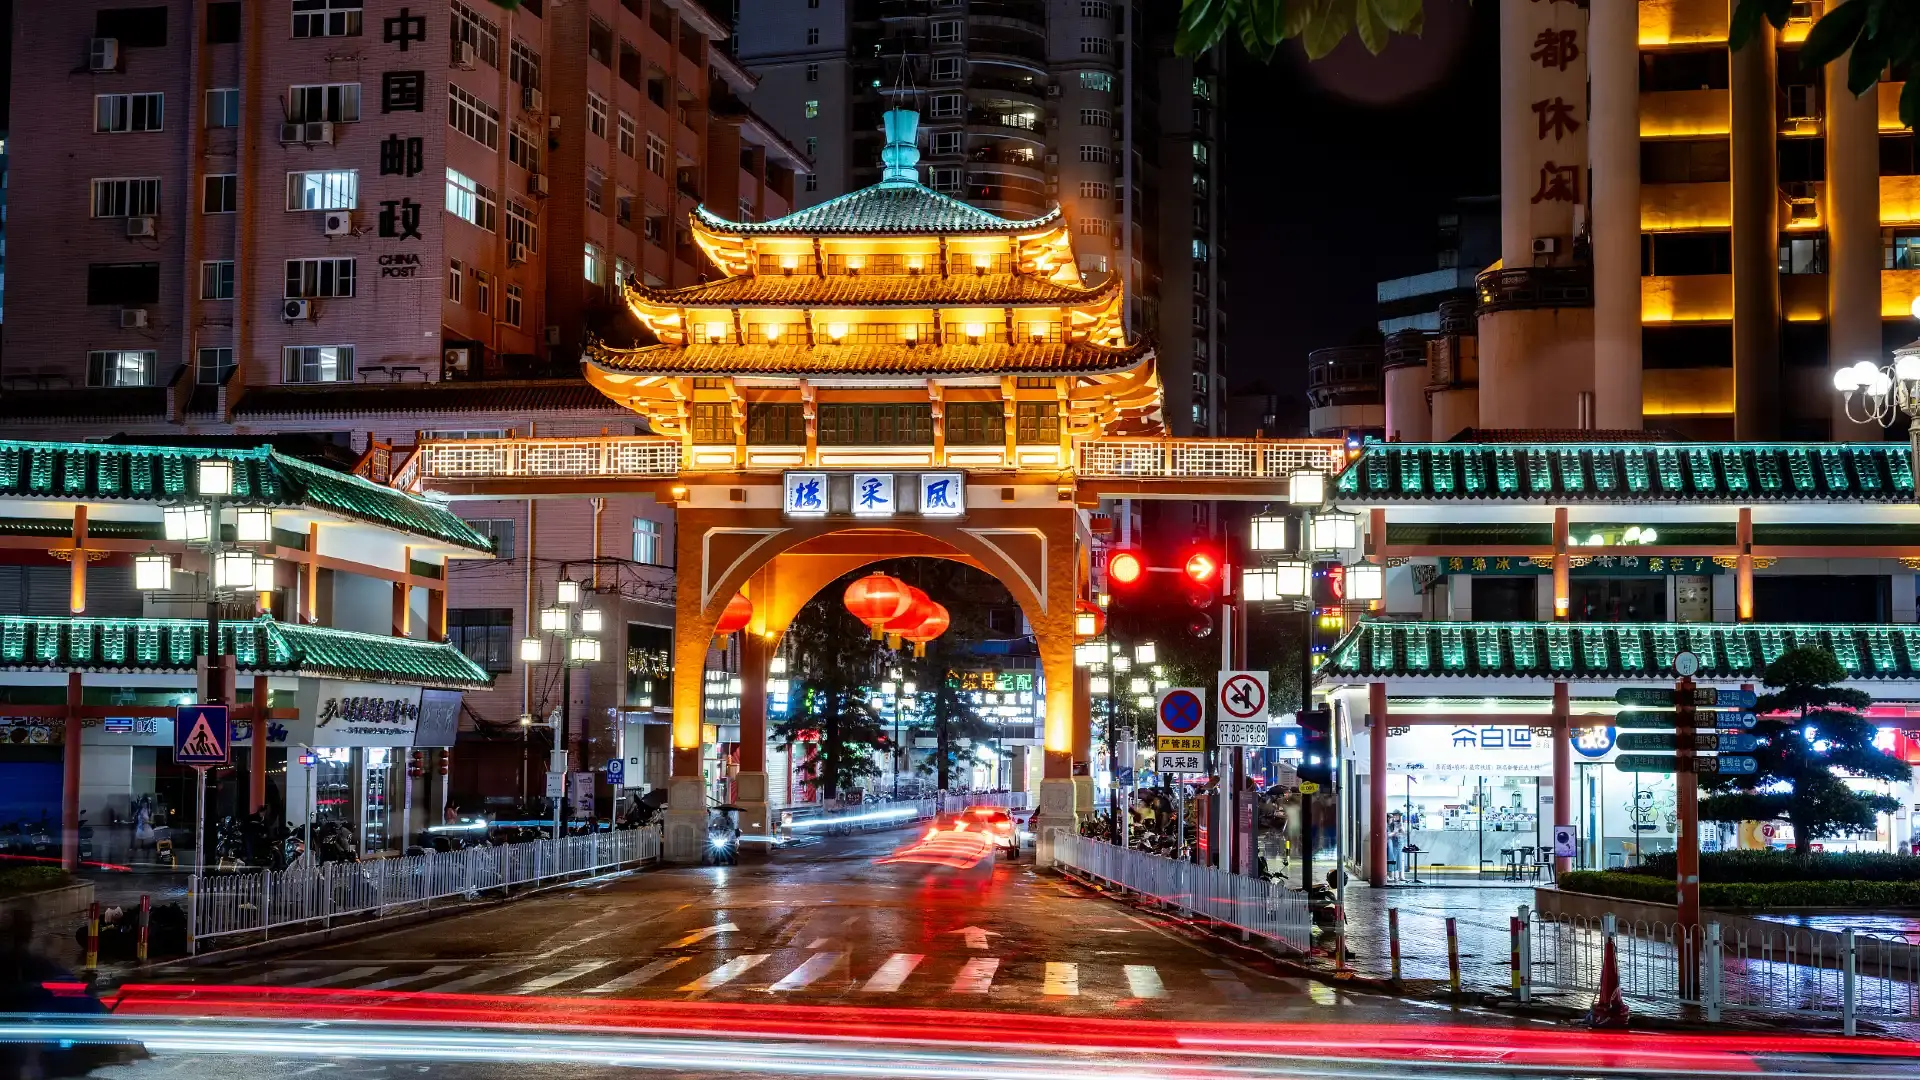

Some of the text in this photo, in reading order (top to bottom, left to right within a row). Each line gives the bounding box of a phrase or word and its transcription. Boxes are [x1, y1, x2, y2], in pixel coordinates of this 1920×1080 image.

[1531, 0, 1580, 204] 都休闲
[378, 7, 426, 241] 中国邮政
[379, 254, 421, 265] CHINA
[382, 267, 416, 278] POST
[1220, 724, 1266, 733] 07:30-09:00
[1160, 739, 1201, 749] 严管路段
[1220, 734, 1266, 743] 17:00-19:00
[1162, 756, 1199, 769] 风采路
